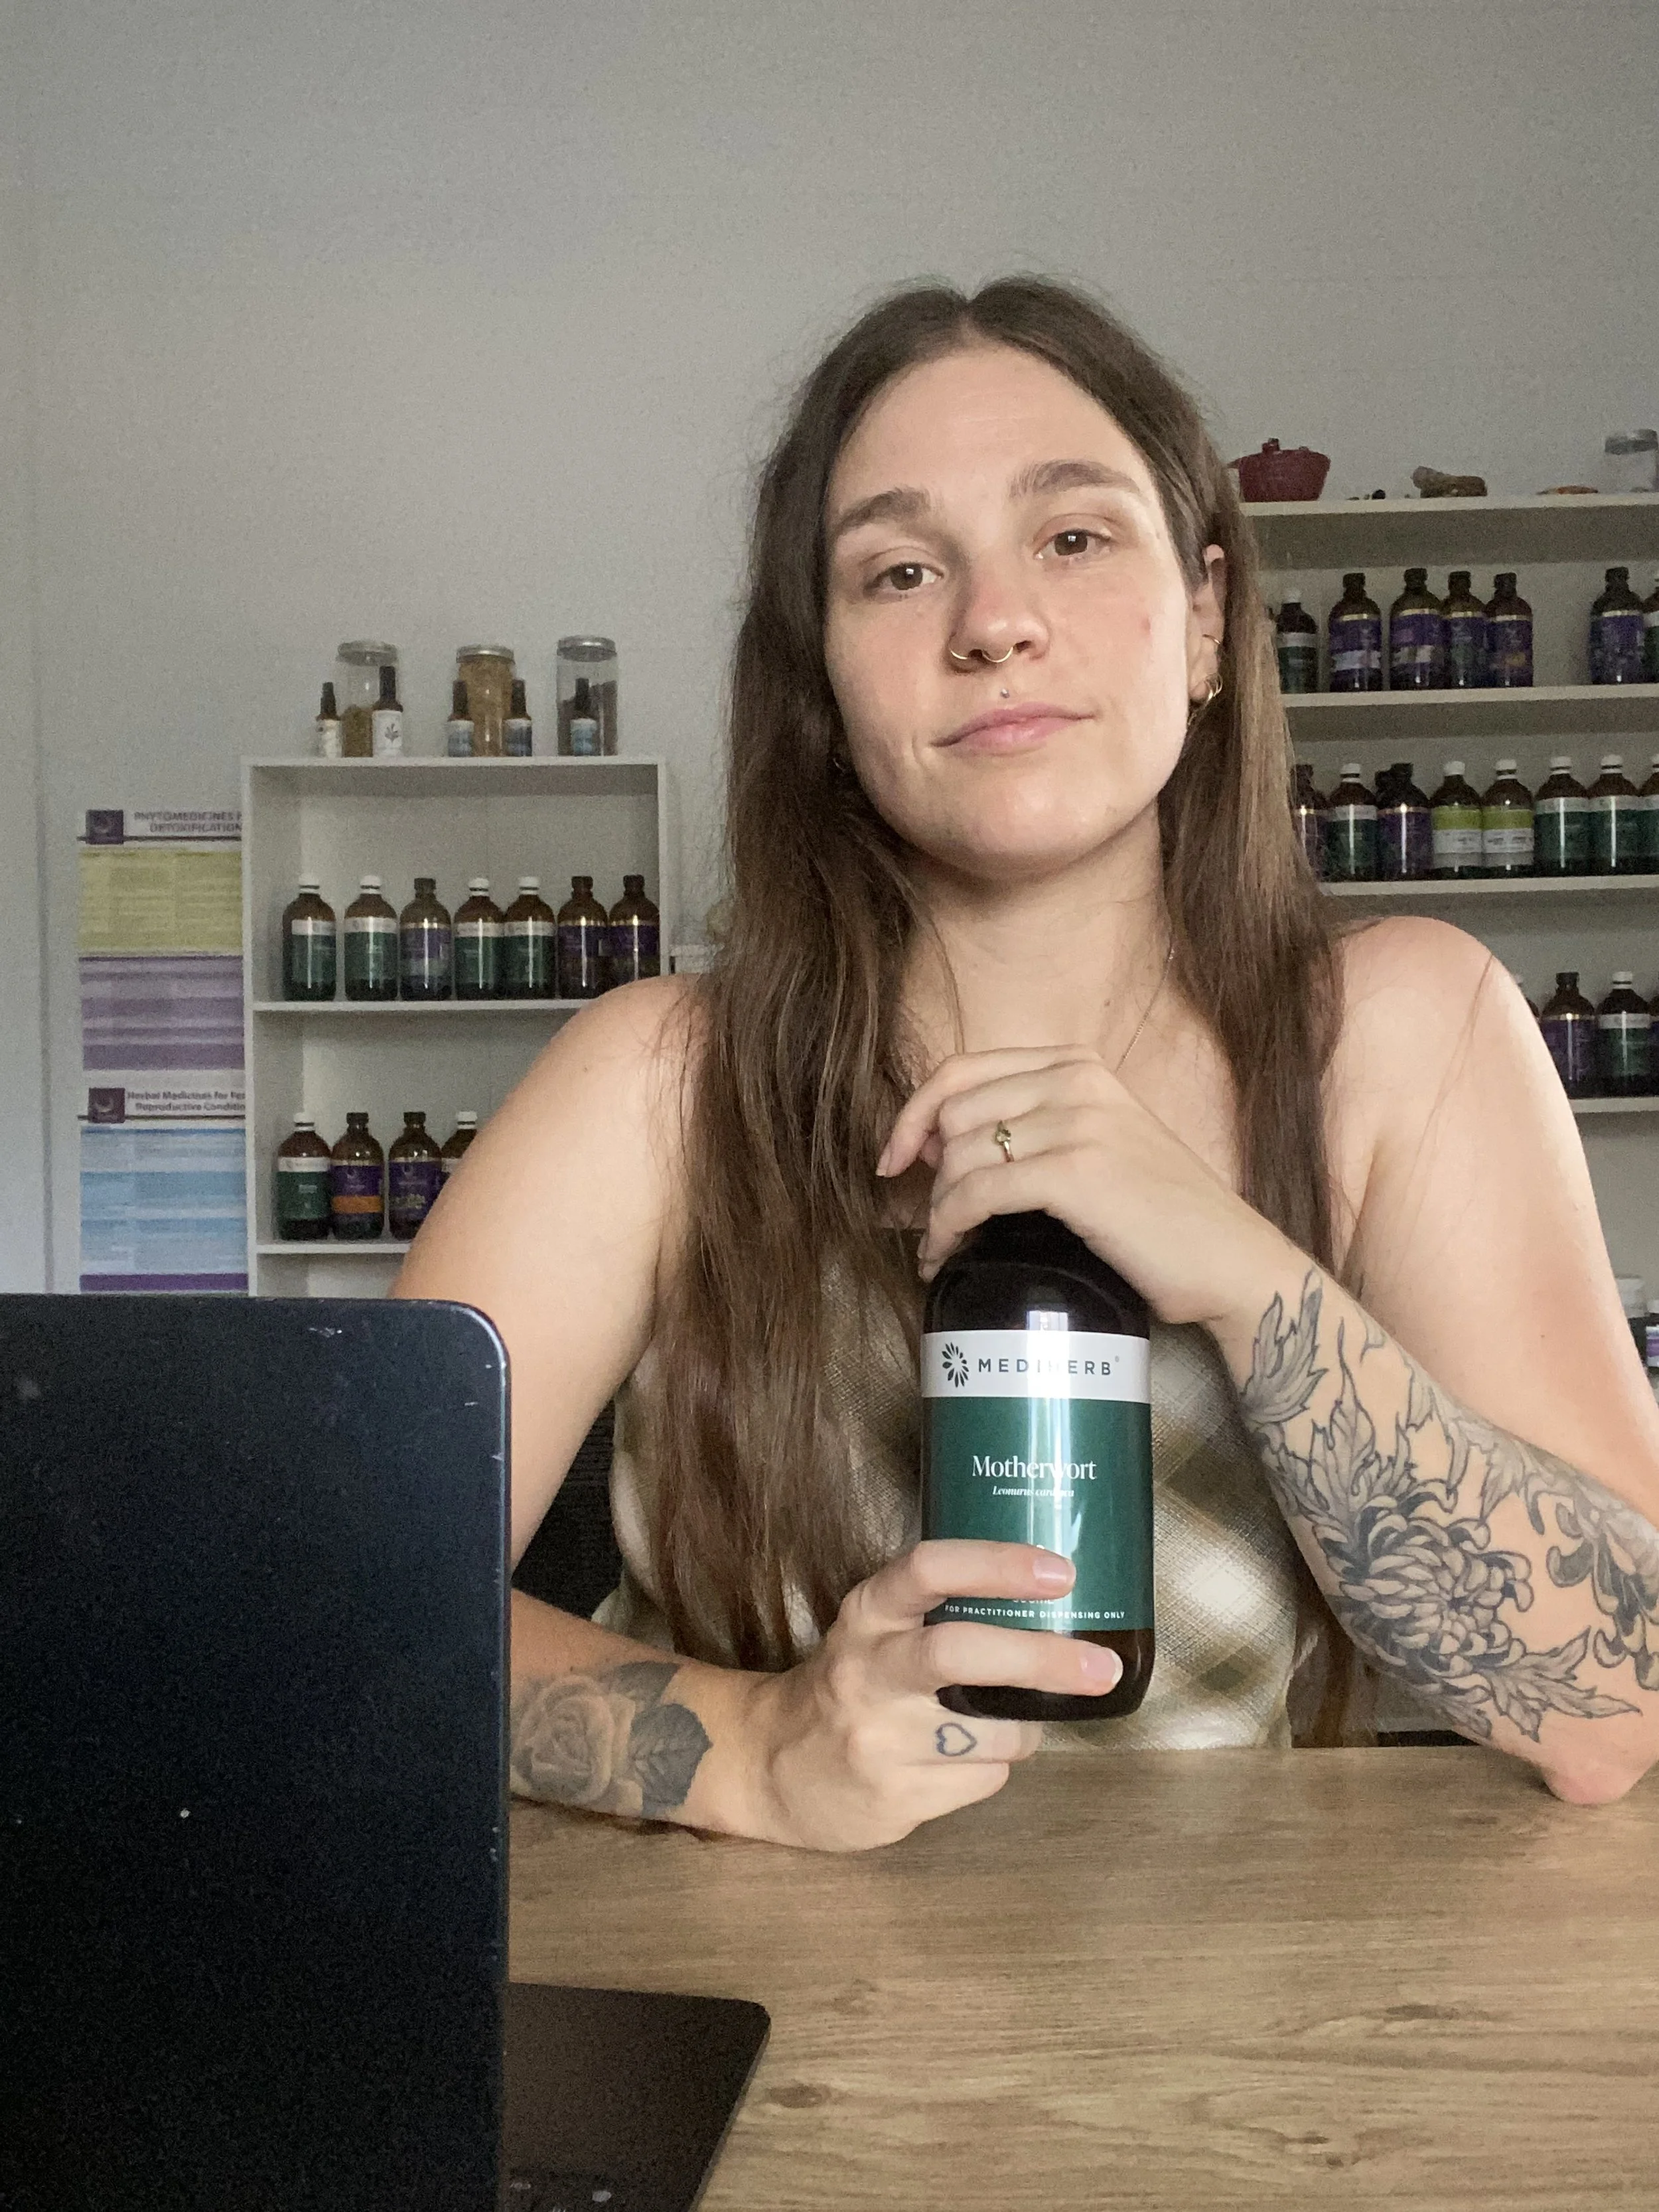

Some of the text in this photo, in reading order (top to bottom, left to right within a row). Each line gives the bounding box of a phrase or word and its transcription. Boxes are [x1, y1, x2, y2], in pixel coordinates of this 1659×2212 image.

[972, 1455, 1098, 1480] Motherwort
[962, 1605, 1035, 1618] PRACTITIONER
[1039, 1611, 1101, 1619] DISPENSING
[1104, 1611, 1125, 1619] ONLY
